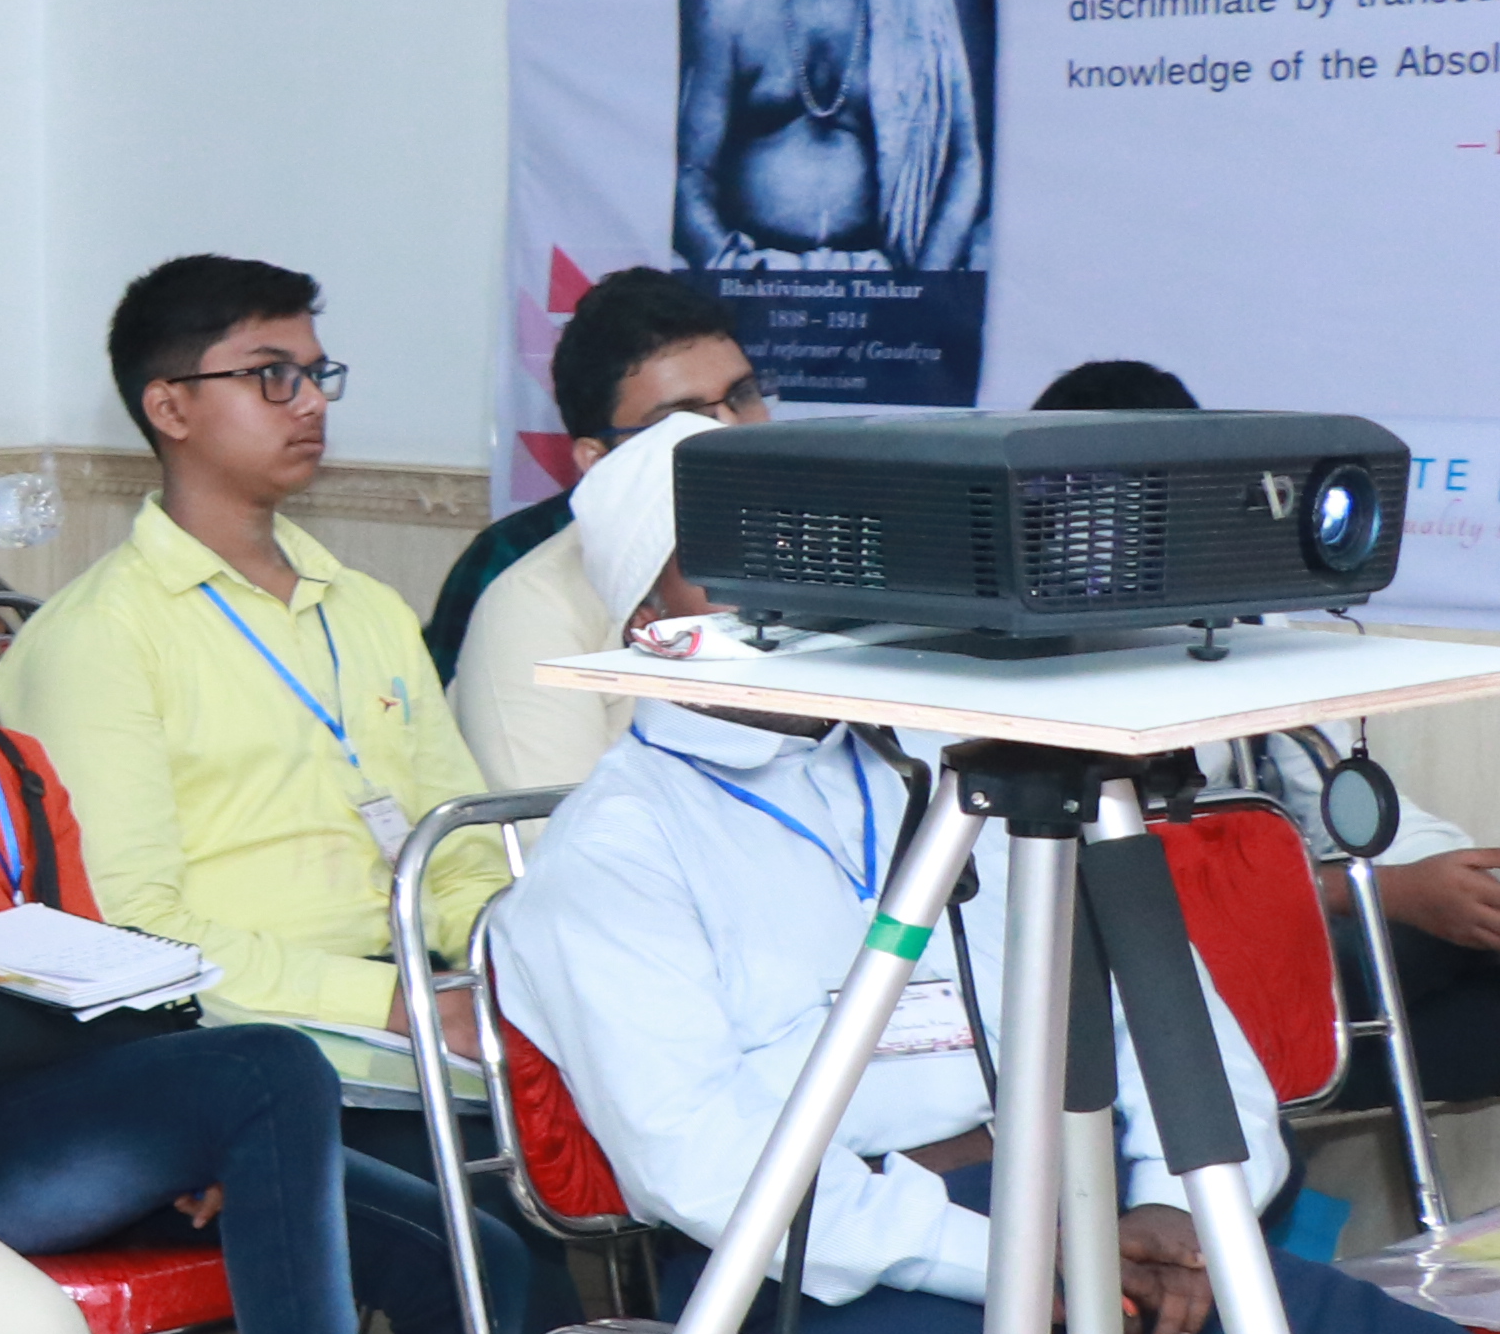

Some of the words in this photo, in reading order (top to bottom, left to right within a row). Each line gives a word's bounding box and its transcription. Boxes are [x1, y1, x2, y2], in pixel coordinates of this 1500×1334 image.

[1068, 56, 1251, 92] knowledge
[1270, 51, 1304, 82] of
[1321, 49, 1378, 79] the
[720, 278, 845, 298] Bhaktivinoda
[852, 280, 923, 298] Thakur
[827, 311, 868, 329] 1914
[847, 341, 861, 362] of
